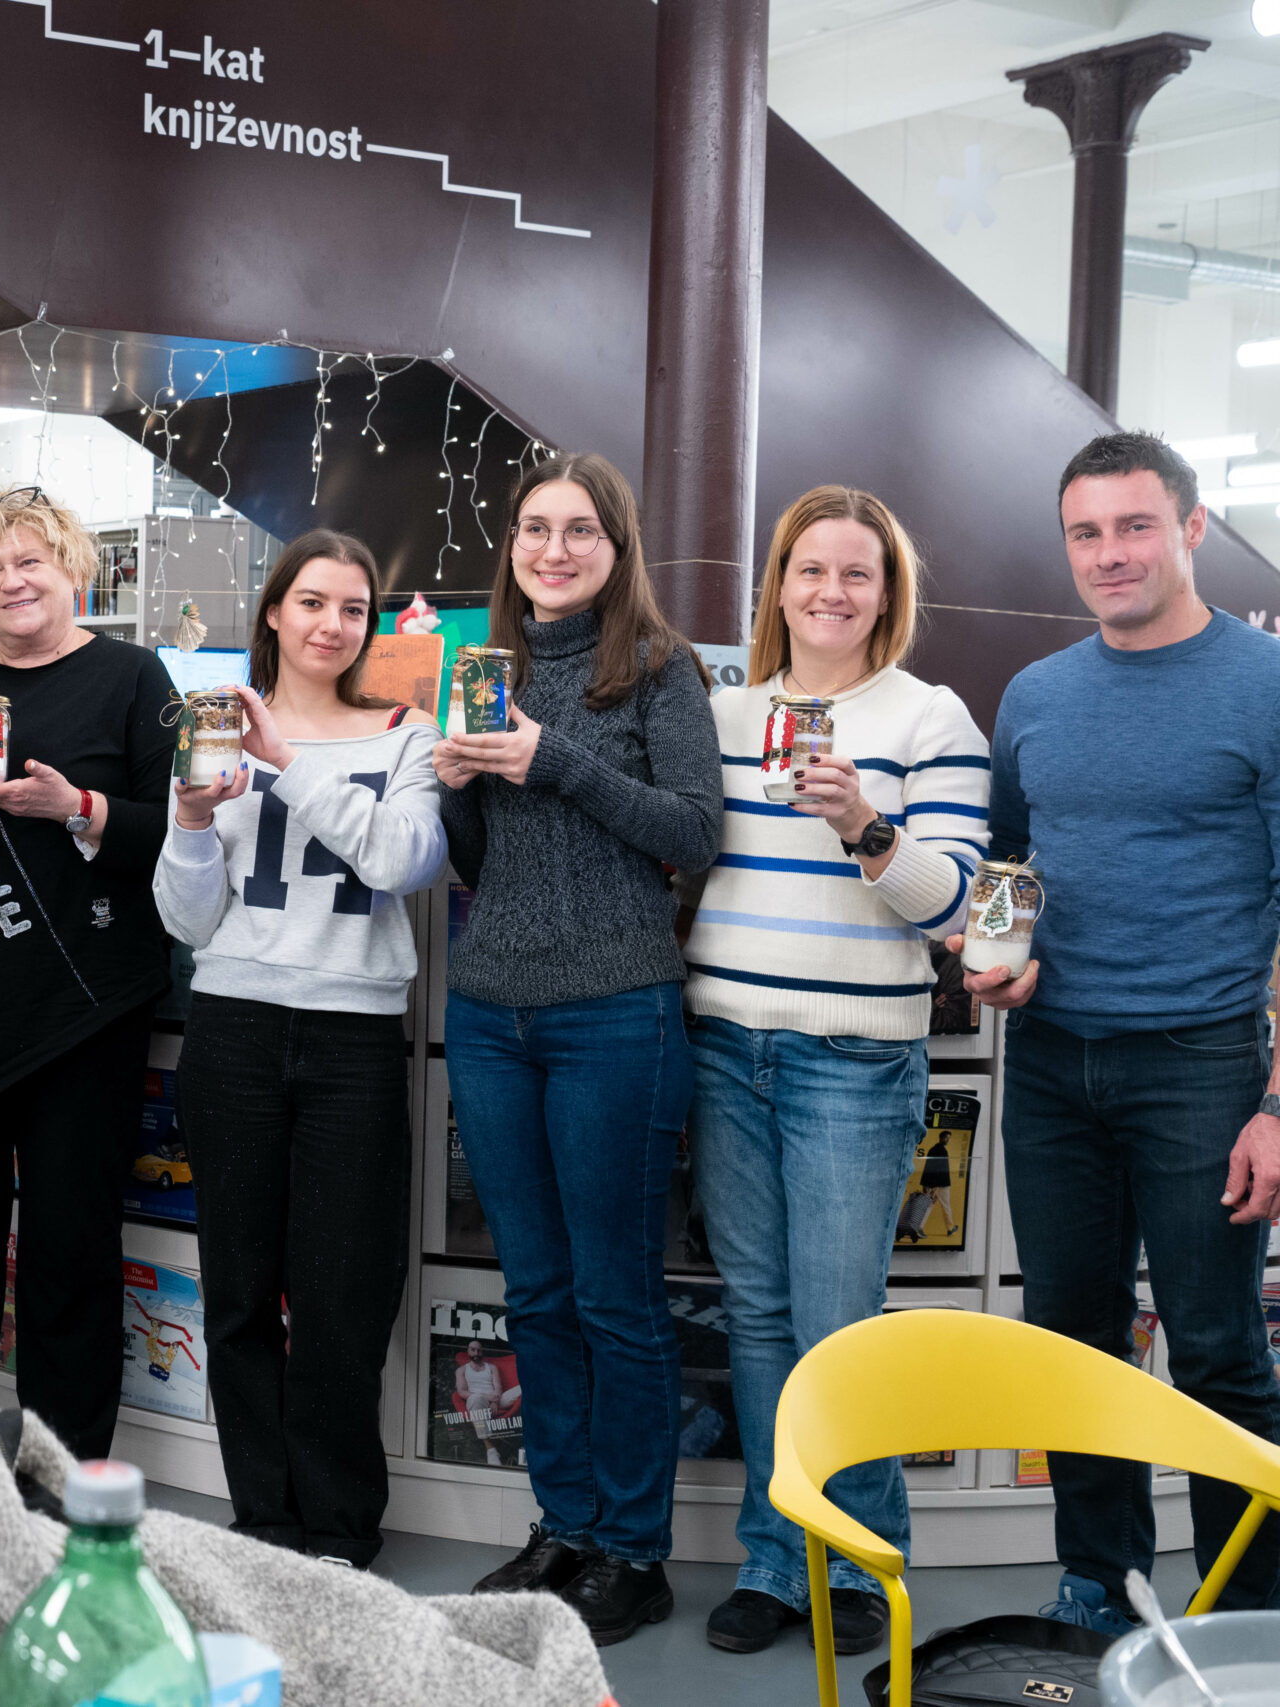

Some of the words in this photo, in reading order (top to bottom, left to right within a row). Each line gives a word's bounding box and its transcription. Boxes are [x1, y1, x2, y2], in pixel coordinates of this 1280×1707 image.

[143, 92, 363, 163] književnost
[442, 1411, 464, 1425] YOUR
[465, 1407, 492, 1421] LAYOFF
[486, 1419, 508, 1432] YOUR
